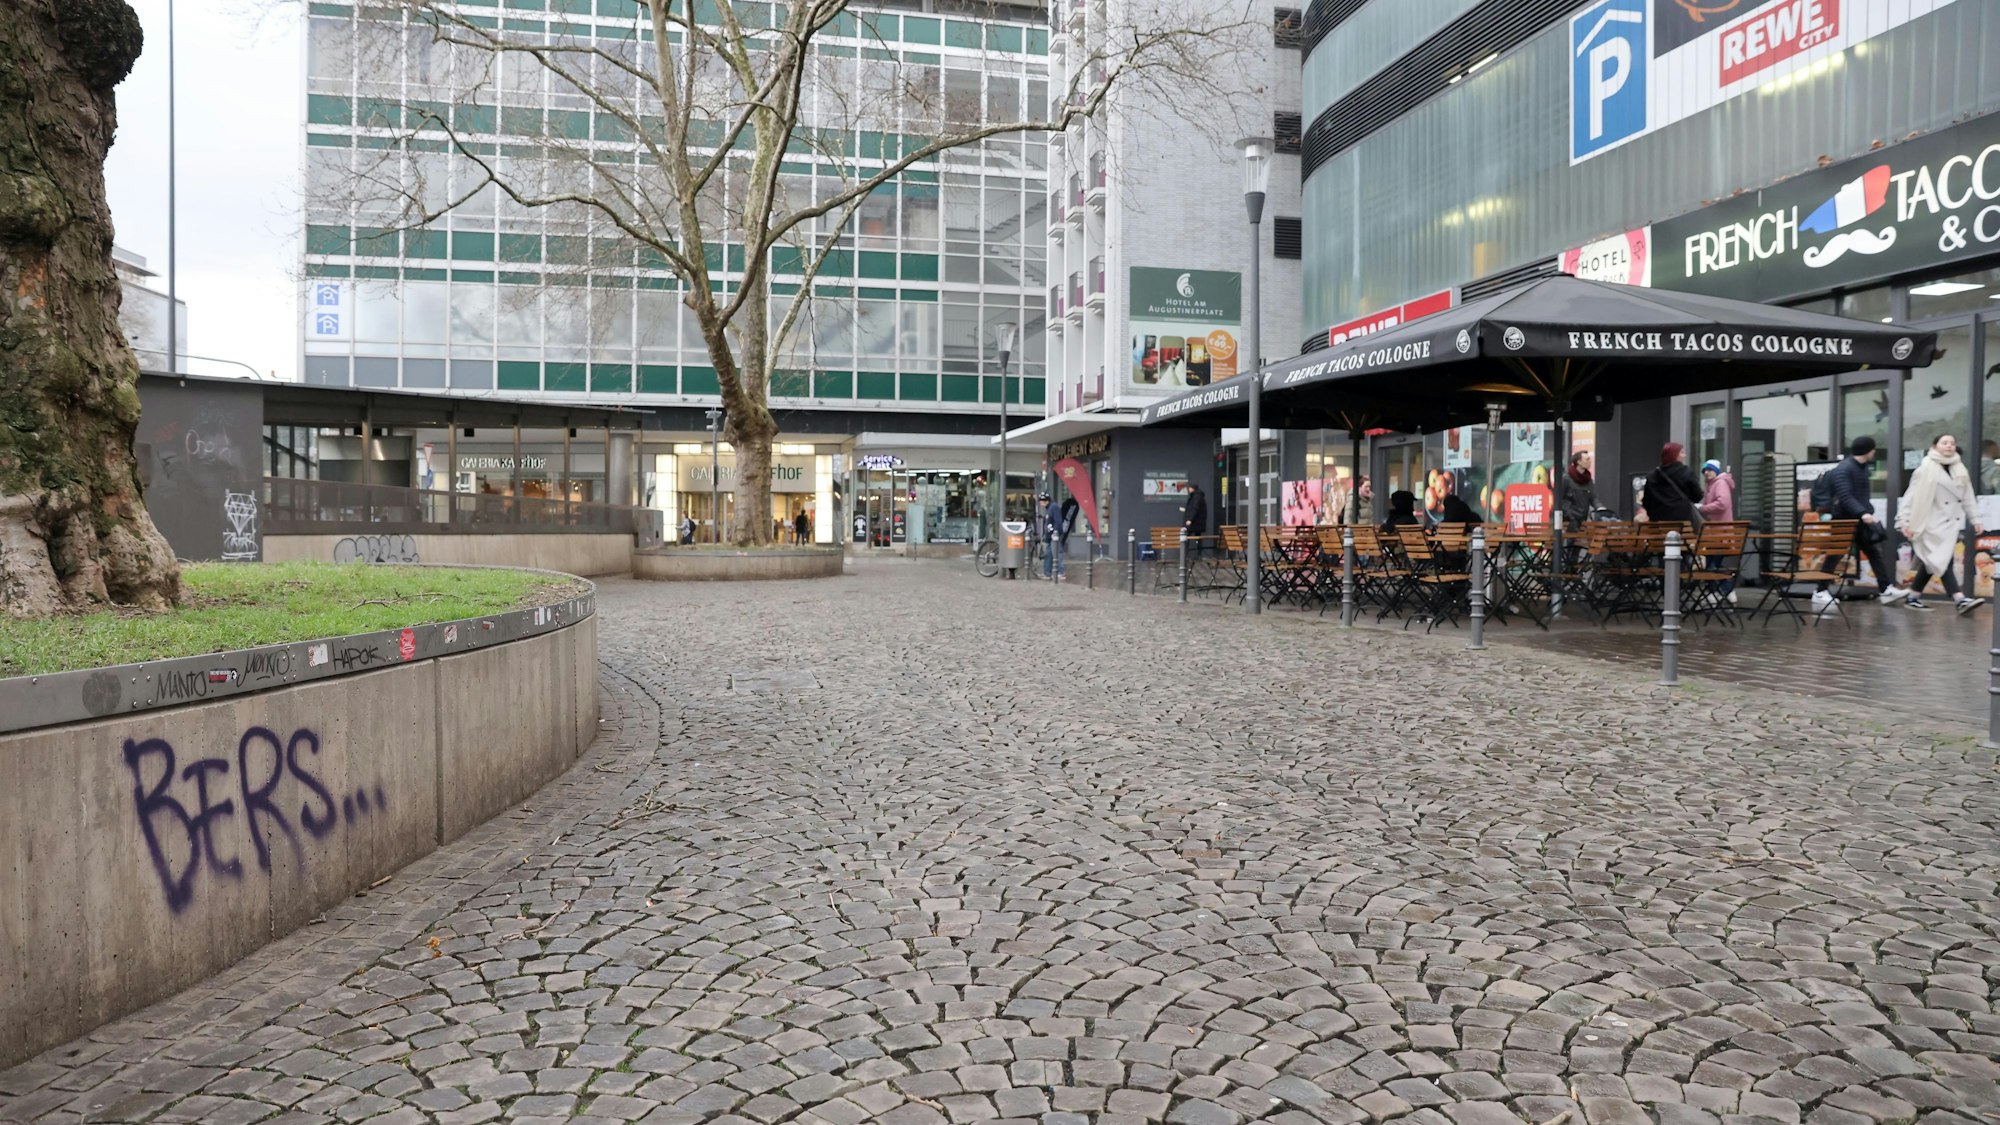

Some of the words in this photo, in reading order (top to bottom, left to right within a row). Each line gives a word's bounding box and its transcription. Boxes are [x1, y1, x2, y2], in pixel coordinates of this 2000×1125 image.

[1722, 0, 1826, 71] REWE
[1799, 23, 1833, 50] CITY
[1590, 36, 1632, 141] P
[1685, 205, 1798, 277] FRENCH
[1938, 214, 1968, 252] &
[1581, 248, 1627, 275] HOTEL
[1148, 304, 1224, 316] AUGUSTINERPLATZ
[1568, 331, 1663, 350] FRENCH
[1671, 333, 1744, 352] TACOS
[1751, 335, 1854, 356] COLOGNE
[1284, 361, 1327, 383] FRENCH
[1327, 352, 1365, 374] TACOS
[1367, 340, 1431, 367] COLOGNE
[1156, 400, 1181, 418] FRENCH
[1181, 393, 1203, 410] TACOS
[1204, 385, 1239, 405] COLOGNE
[1089, 434, 1109, 452] SHOP
[863, 455, 893, 463] Service
[1510, 495, 1543, 511] REWE
